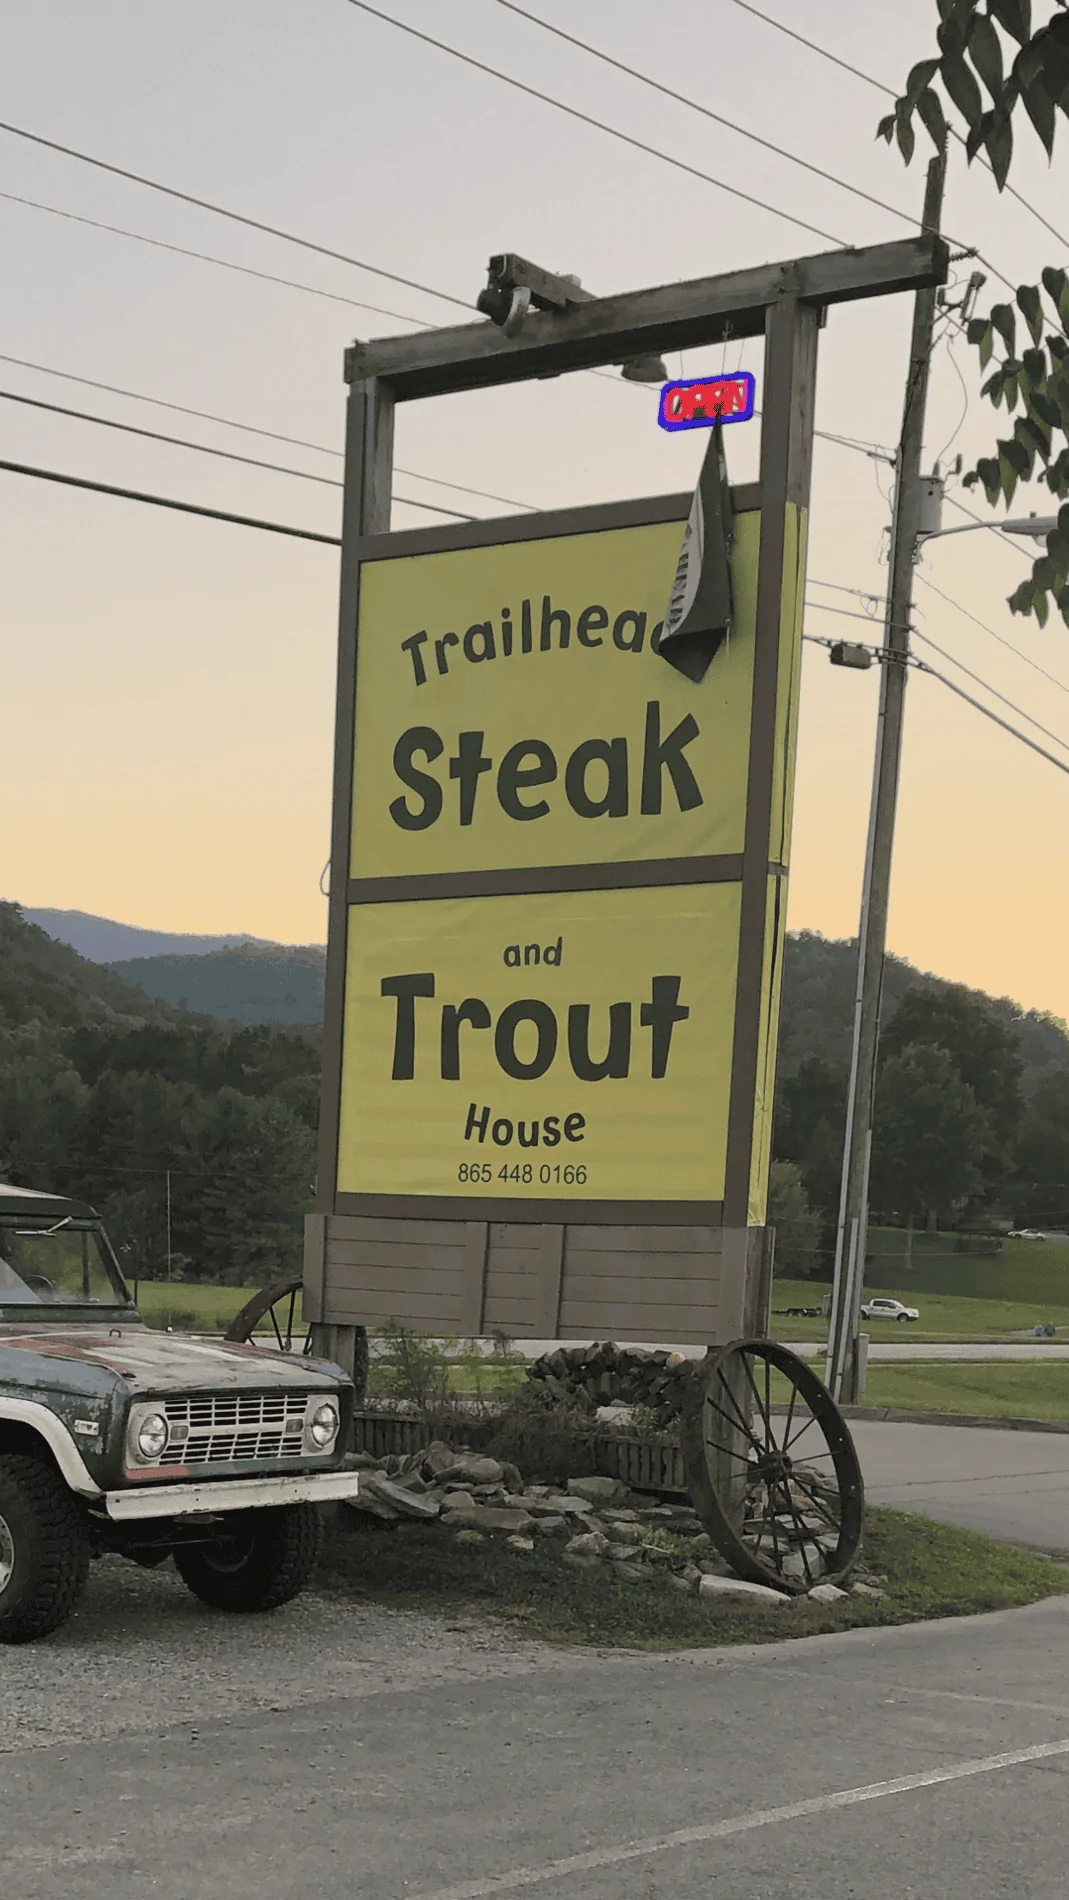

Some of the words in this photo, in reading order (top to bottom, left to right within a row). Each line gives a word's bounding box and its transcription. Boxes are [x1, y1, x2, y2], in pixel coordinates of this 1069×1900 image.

[389, 701, 703, 831] Steak
[503, 937, 563, 967] and
[381, 973, 689, 1081] Trout
[464, 1103, 586, 1147] House
[458, 1163, 492, 1183] 865
[498, 1164, 533, 1184] 448
[540, 1164, 587, 1185] 0166
